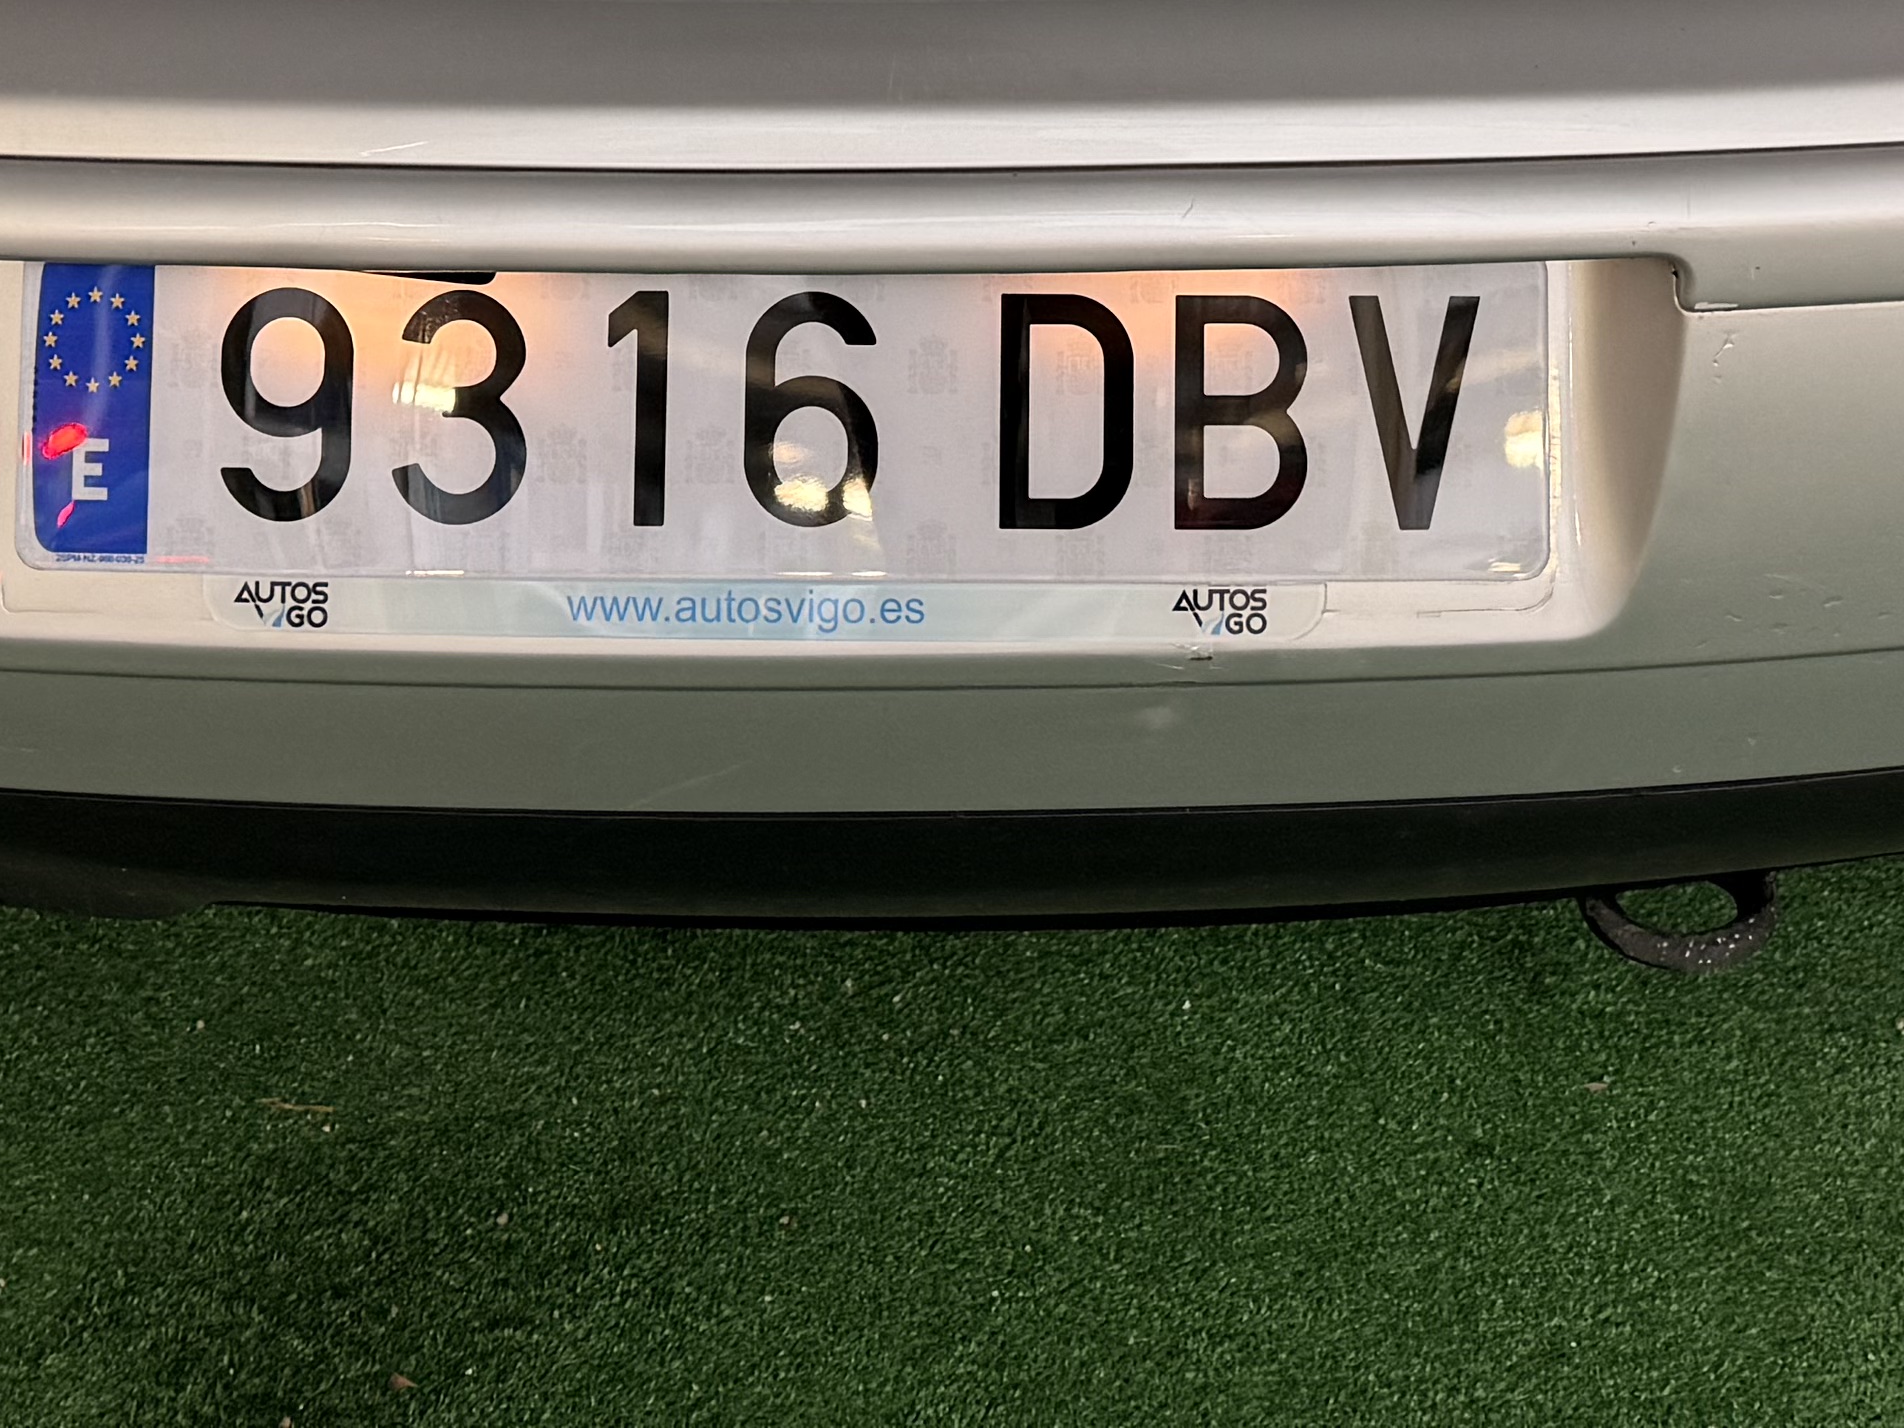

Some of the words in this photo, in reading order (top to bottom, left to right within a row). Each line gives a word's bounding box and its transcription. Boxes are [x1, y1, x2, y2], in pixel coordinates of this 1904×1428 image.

[221, 287, 879, 527] 9316
[999, 293, 1481, 531] DBV
[72, 437, 109, 501] E
[233, 580, 329, 604] AUTOS
[567, 590, 926, 632] www.autosvigo.es
[1172, 588, 1267, 612] AUTOS
